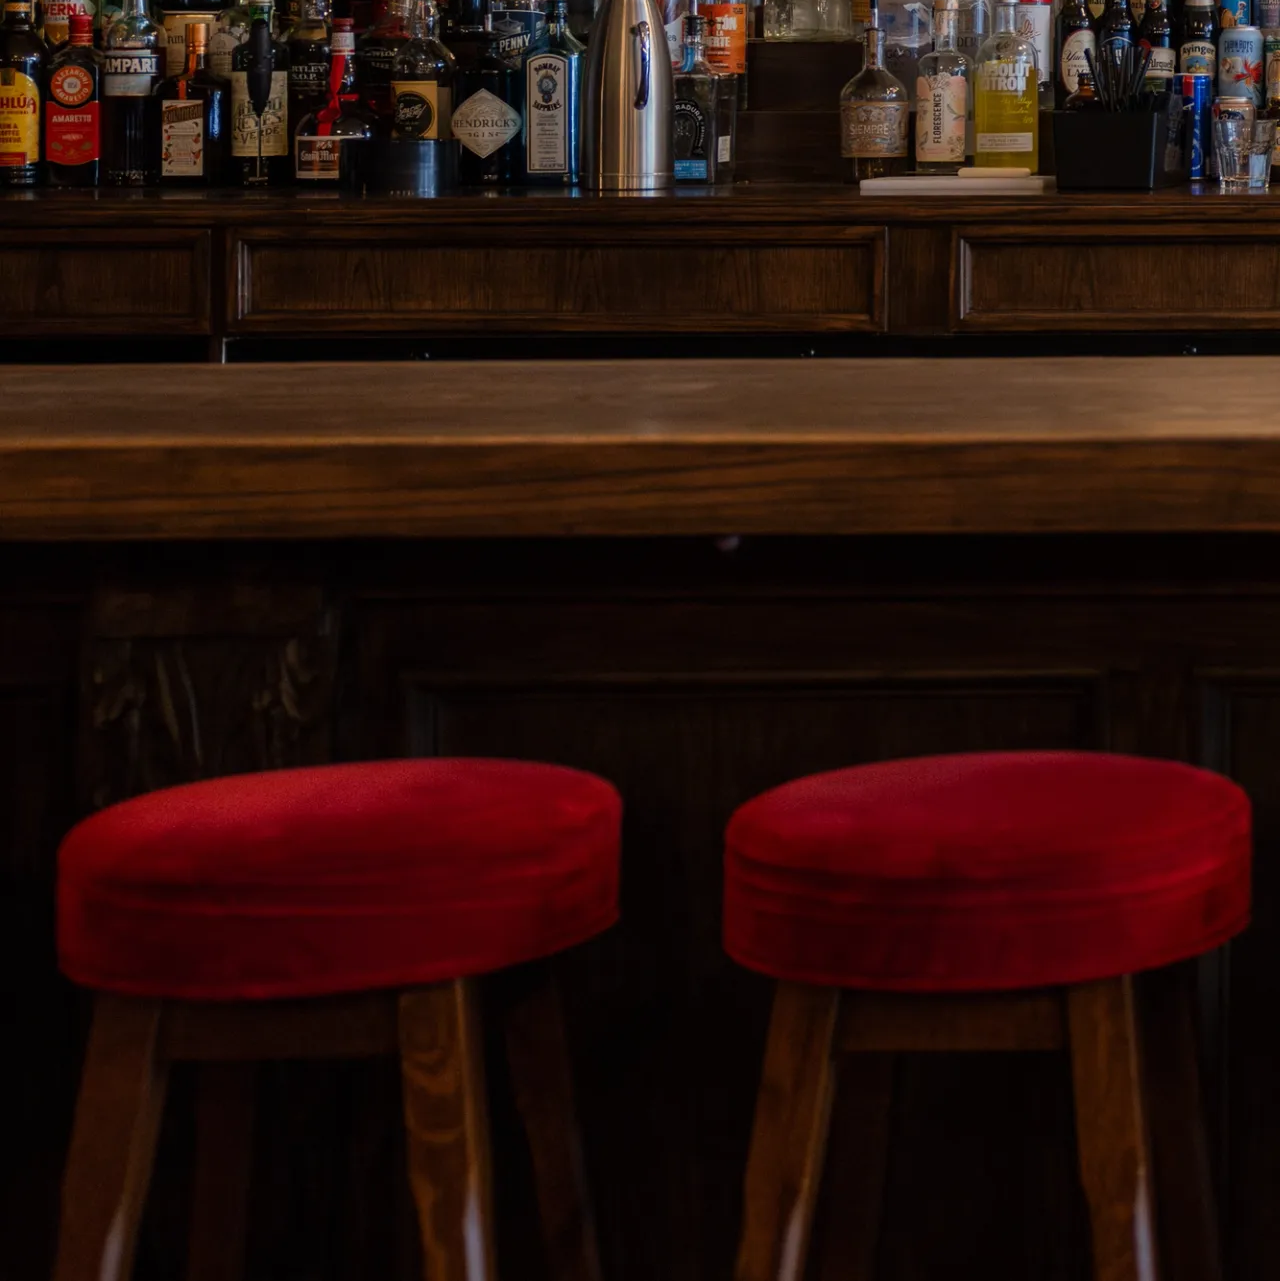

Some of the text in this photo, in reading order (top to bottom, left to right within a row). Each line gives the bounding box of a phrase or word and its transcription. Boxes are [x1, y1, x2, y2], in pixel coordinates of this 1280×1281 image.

[500, 33, 531, 53] PENNY
[1182, 44, 1215, 55] Ayinger
[534, 63, 561, 75] BOMBAY
[532, 100, 562, 111] SAPPHIRE
[52, 114, 92, 123] AMARETTO
[933, 92, 942, 144] FLORESCENCE
[241, 127, 280, 144] VERDE
[849, 124, 890, 136] SIEMPRE
